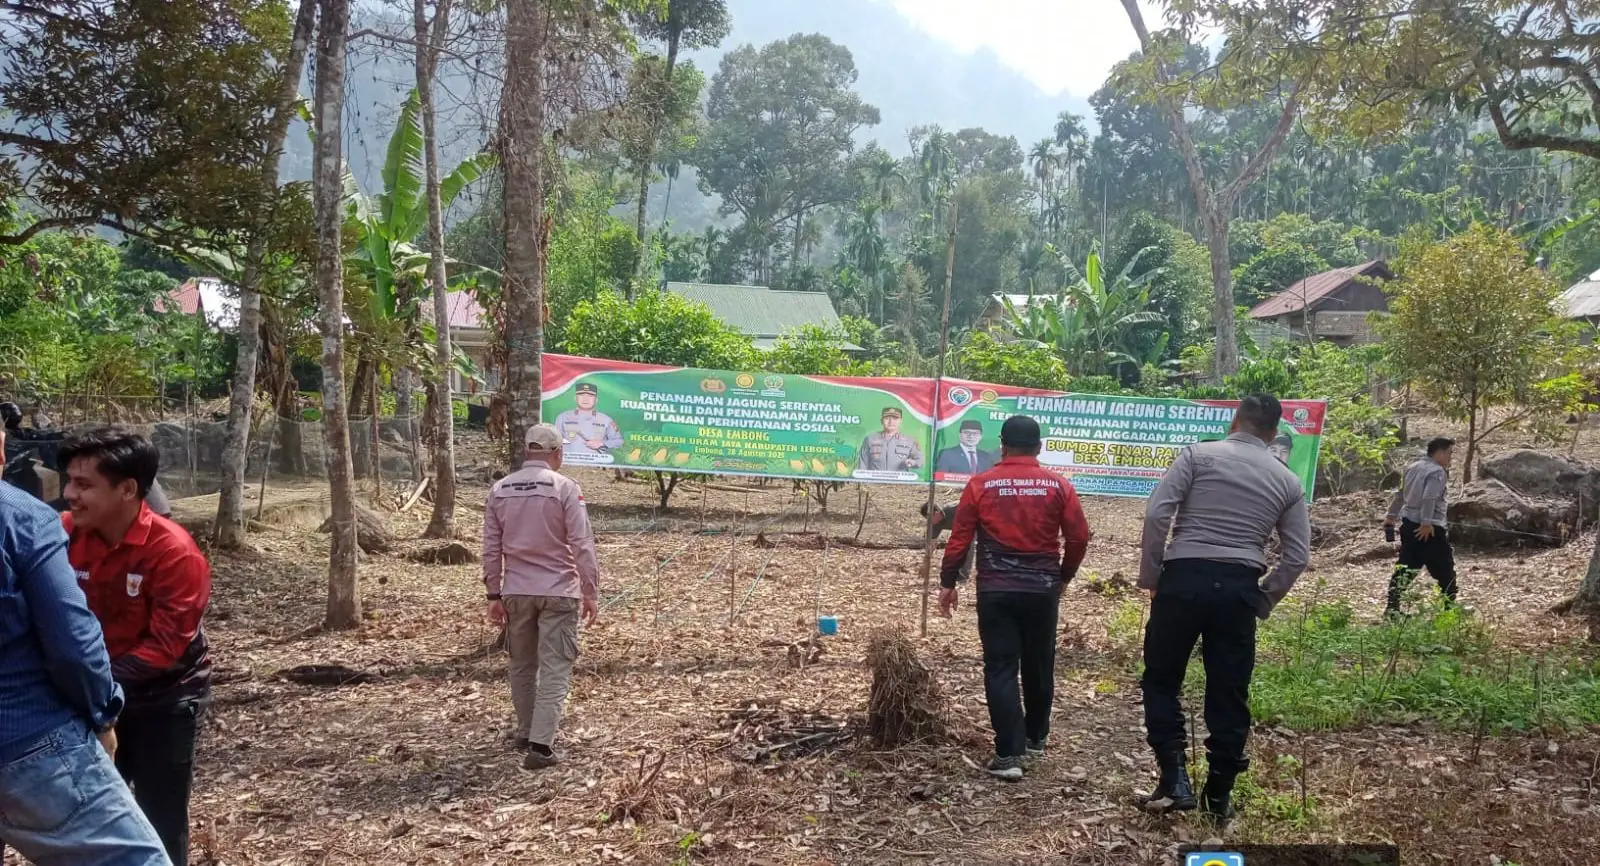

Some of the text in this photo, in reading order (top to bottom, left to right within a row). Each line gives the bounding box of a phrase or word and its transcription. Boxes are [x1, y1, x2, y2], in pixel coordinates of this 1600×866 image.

[640, 391, 724, 406] PENANAMAN
[726, 397, 776, 409] JAGUNG
[780, 400, 841, 412] SERENTAK
[1017, 396, 1106, 415] PENANAMAN
[1108, 401, 1165, 419] JAGUNG
[620, 399, 860, 424] KUARTAL III DAN PENANAMAN JAGUNG
[643, 411, 836, 433] DI LAHAN PERHUTANAN SOSIAL
[1054, 415, 1130, 429] KETAHANAN
[1133, 419, 1186, 432] PANGAN
[1189, 423, 1225, 434] DANA
[699, 428, 769, 441] DESA EMBONG
[1049, 427, 1198, 443] TAHUN ANGGARAN 2025
[631, 434, 686, 444] KECAMATAN
[689, 438, 718, 446] URAM
[745, 441, 797, 452] KABUPATEN
[800, 445, 835, 454] LEBONG
[1046, 440, 1105, 454] BUMDES
[1108, 444, 1152, 457] SINAR
[738, 449, 766, 457] Agustus
[1073, 452, 1109, 465] DESA
[984, 478, 1011, 489] BUMDES
[1013, 478, 1034, 487] SINAR
[999, 488, 1047, 496] DESA EMBONG
